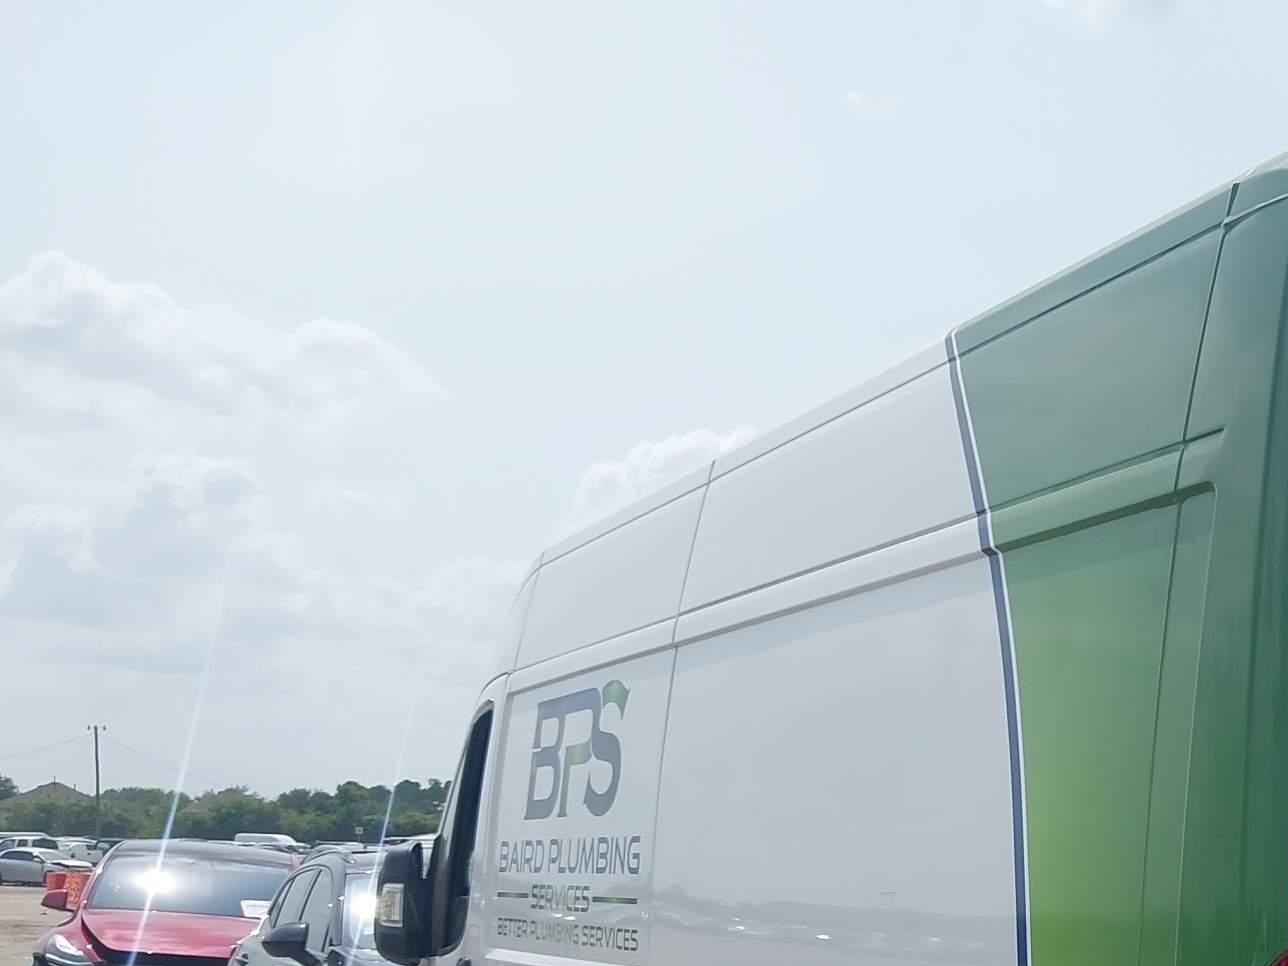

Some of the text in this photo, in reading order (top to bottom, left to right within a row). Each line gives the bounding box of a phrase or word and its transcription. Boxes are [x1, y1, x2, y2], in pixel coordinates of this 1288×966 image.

[524, 679, 631, 820] BPS
[498, 835, 641, 875] BAIRD PLUMBING
[530, 883, 592, 913] SERVICES
[497, 916, 529, 940] BETTER
[581, 925, 639, 952] SERVICES
